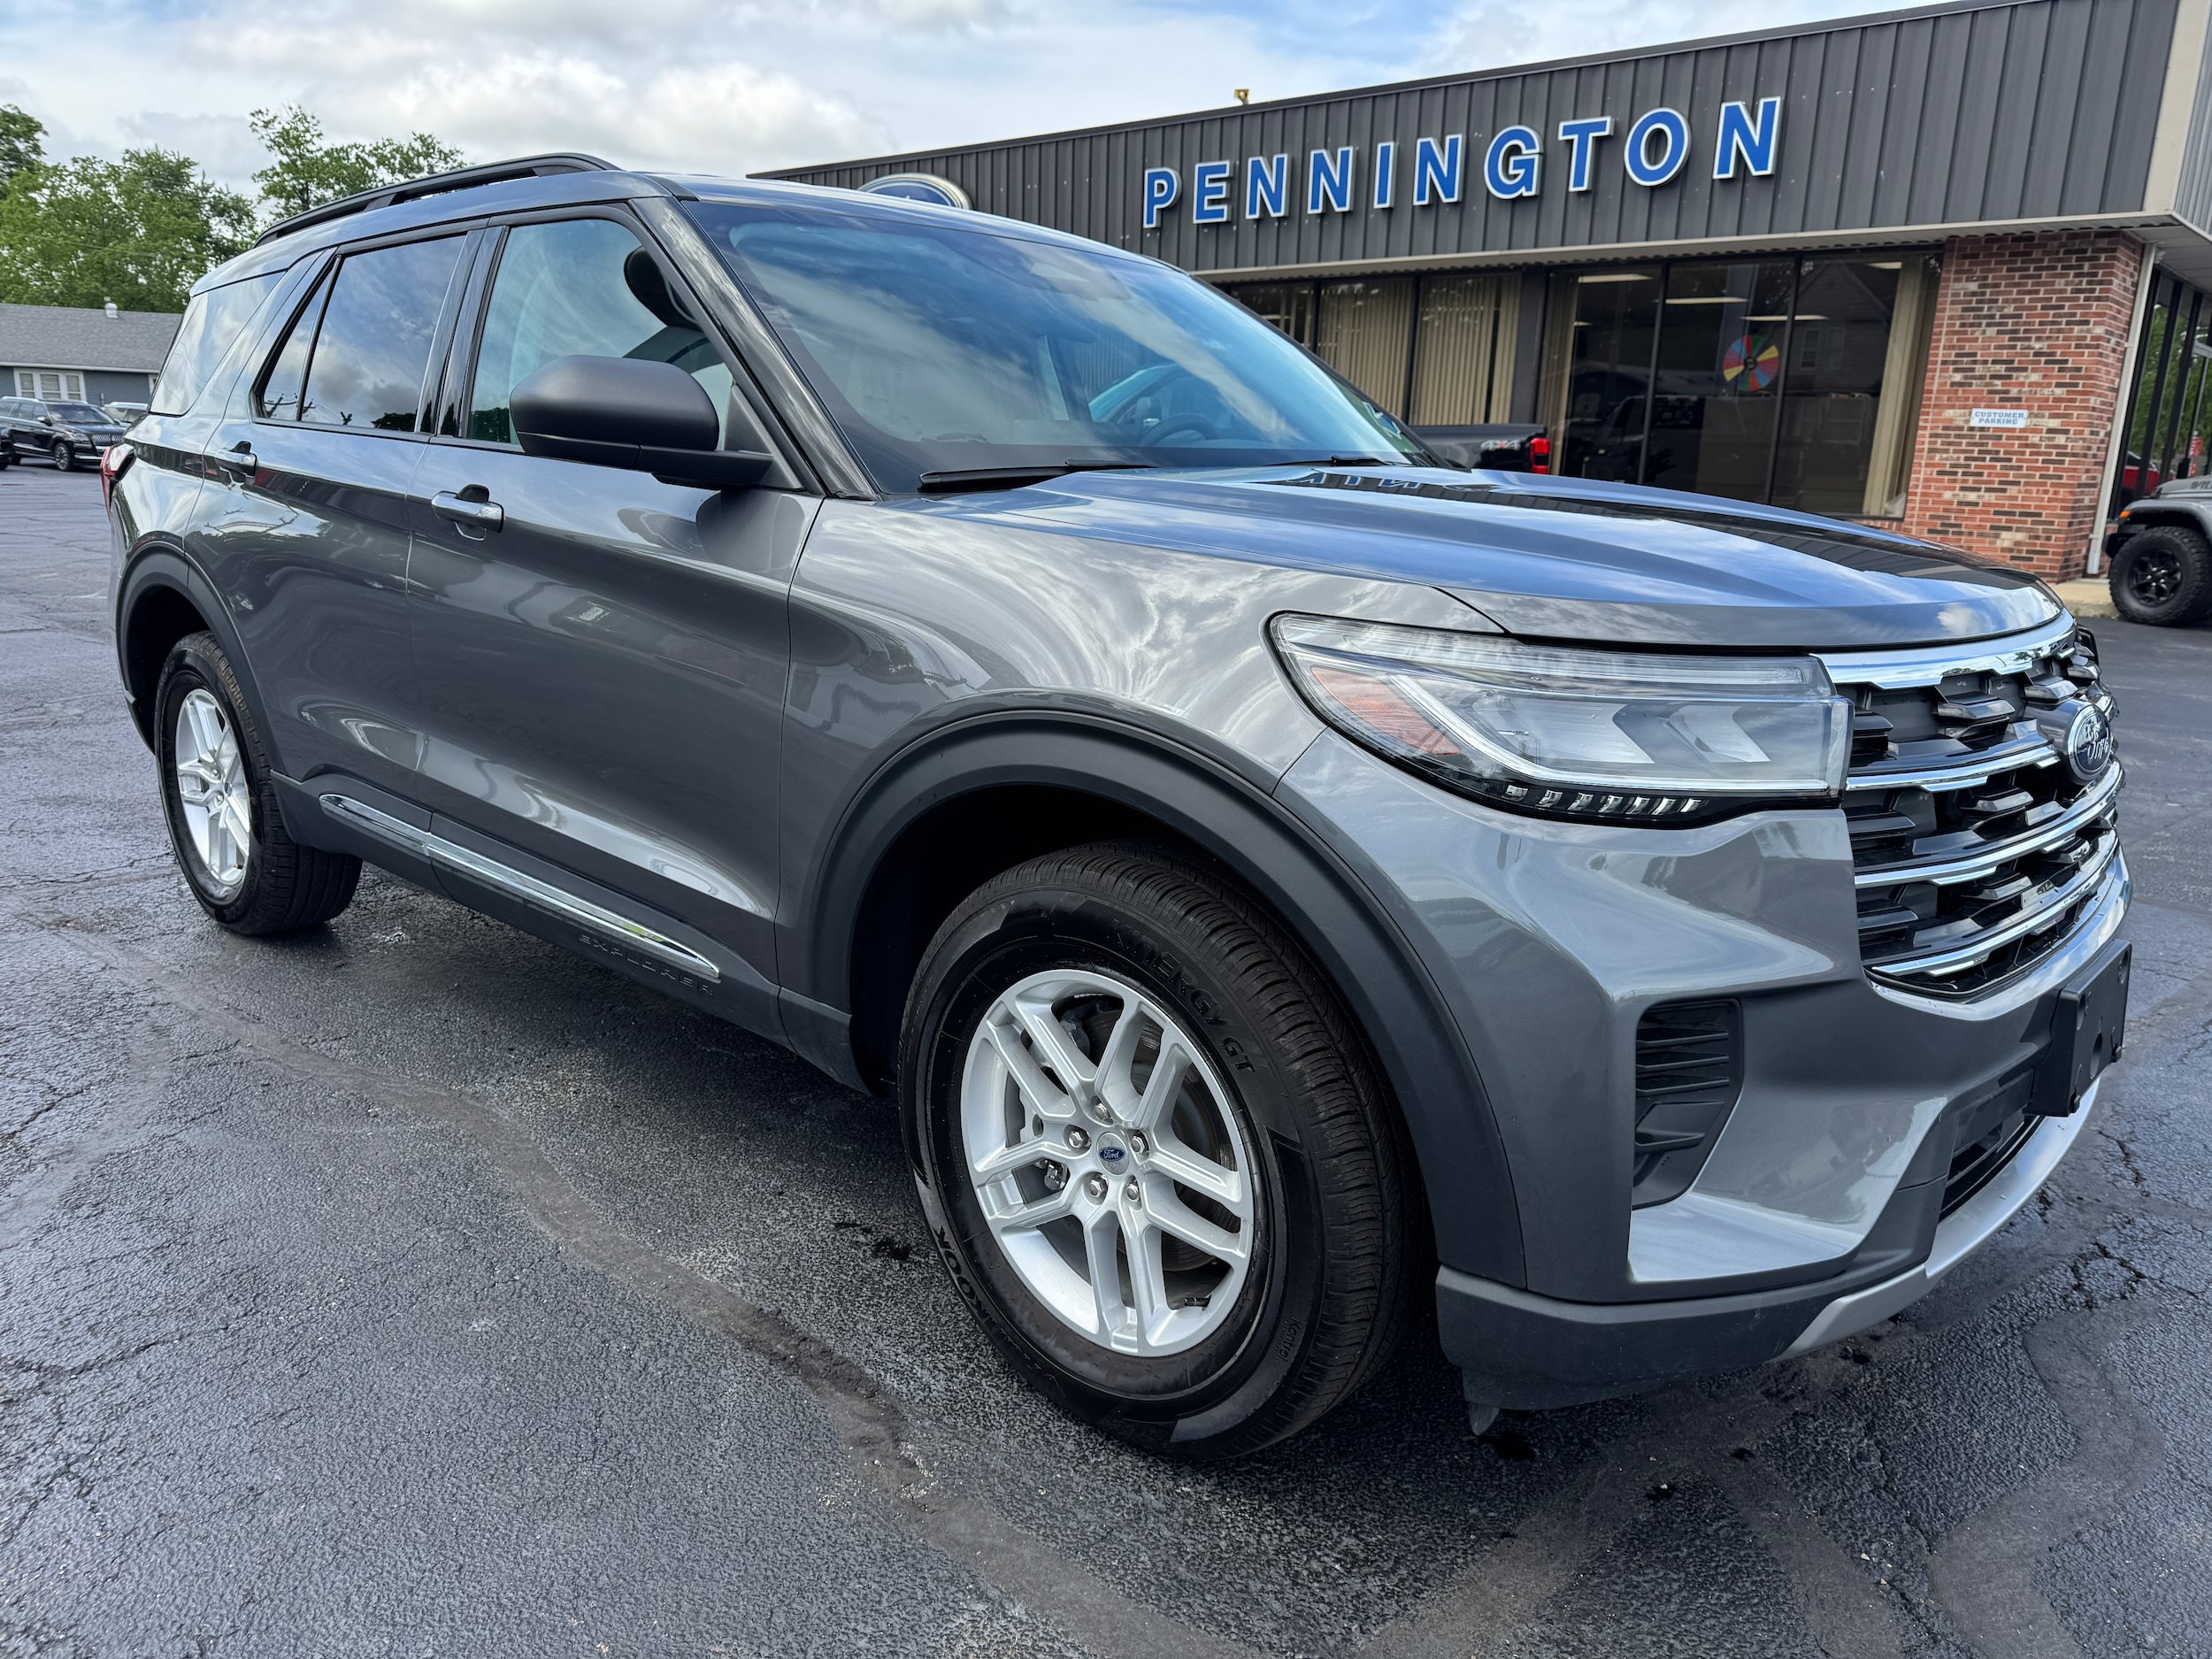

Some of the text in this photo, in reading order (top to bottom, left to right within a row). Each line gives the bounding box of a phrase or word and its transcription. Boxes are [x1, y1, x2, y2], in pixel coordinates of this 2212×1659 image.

[1142, 96, 1782, 229] PENNINGTON
[2191, 480, 2212, 490] WIL
[579, 933, 713, 996] EXPLORER
[1222, 1036, 1256, 1073] GT
